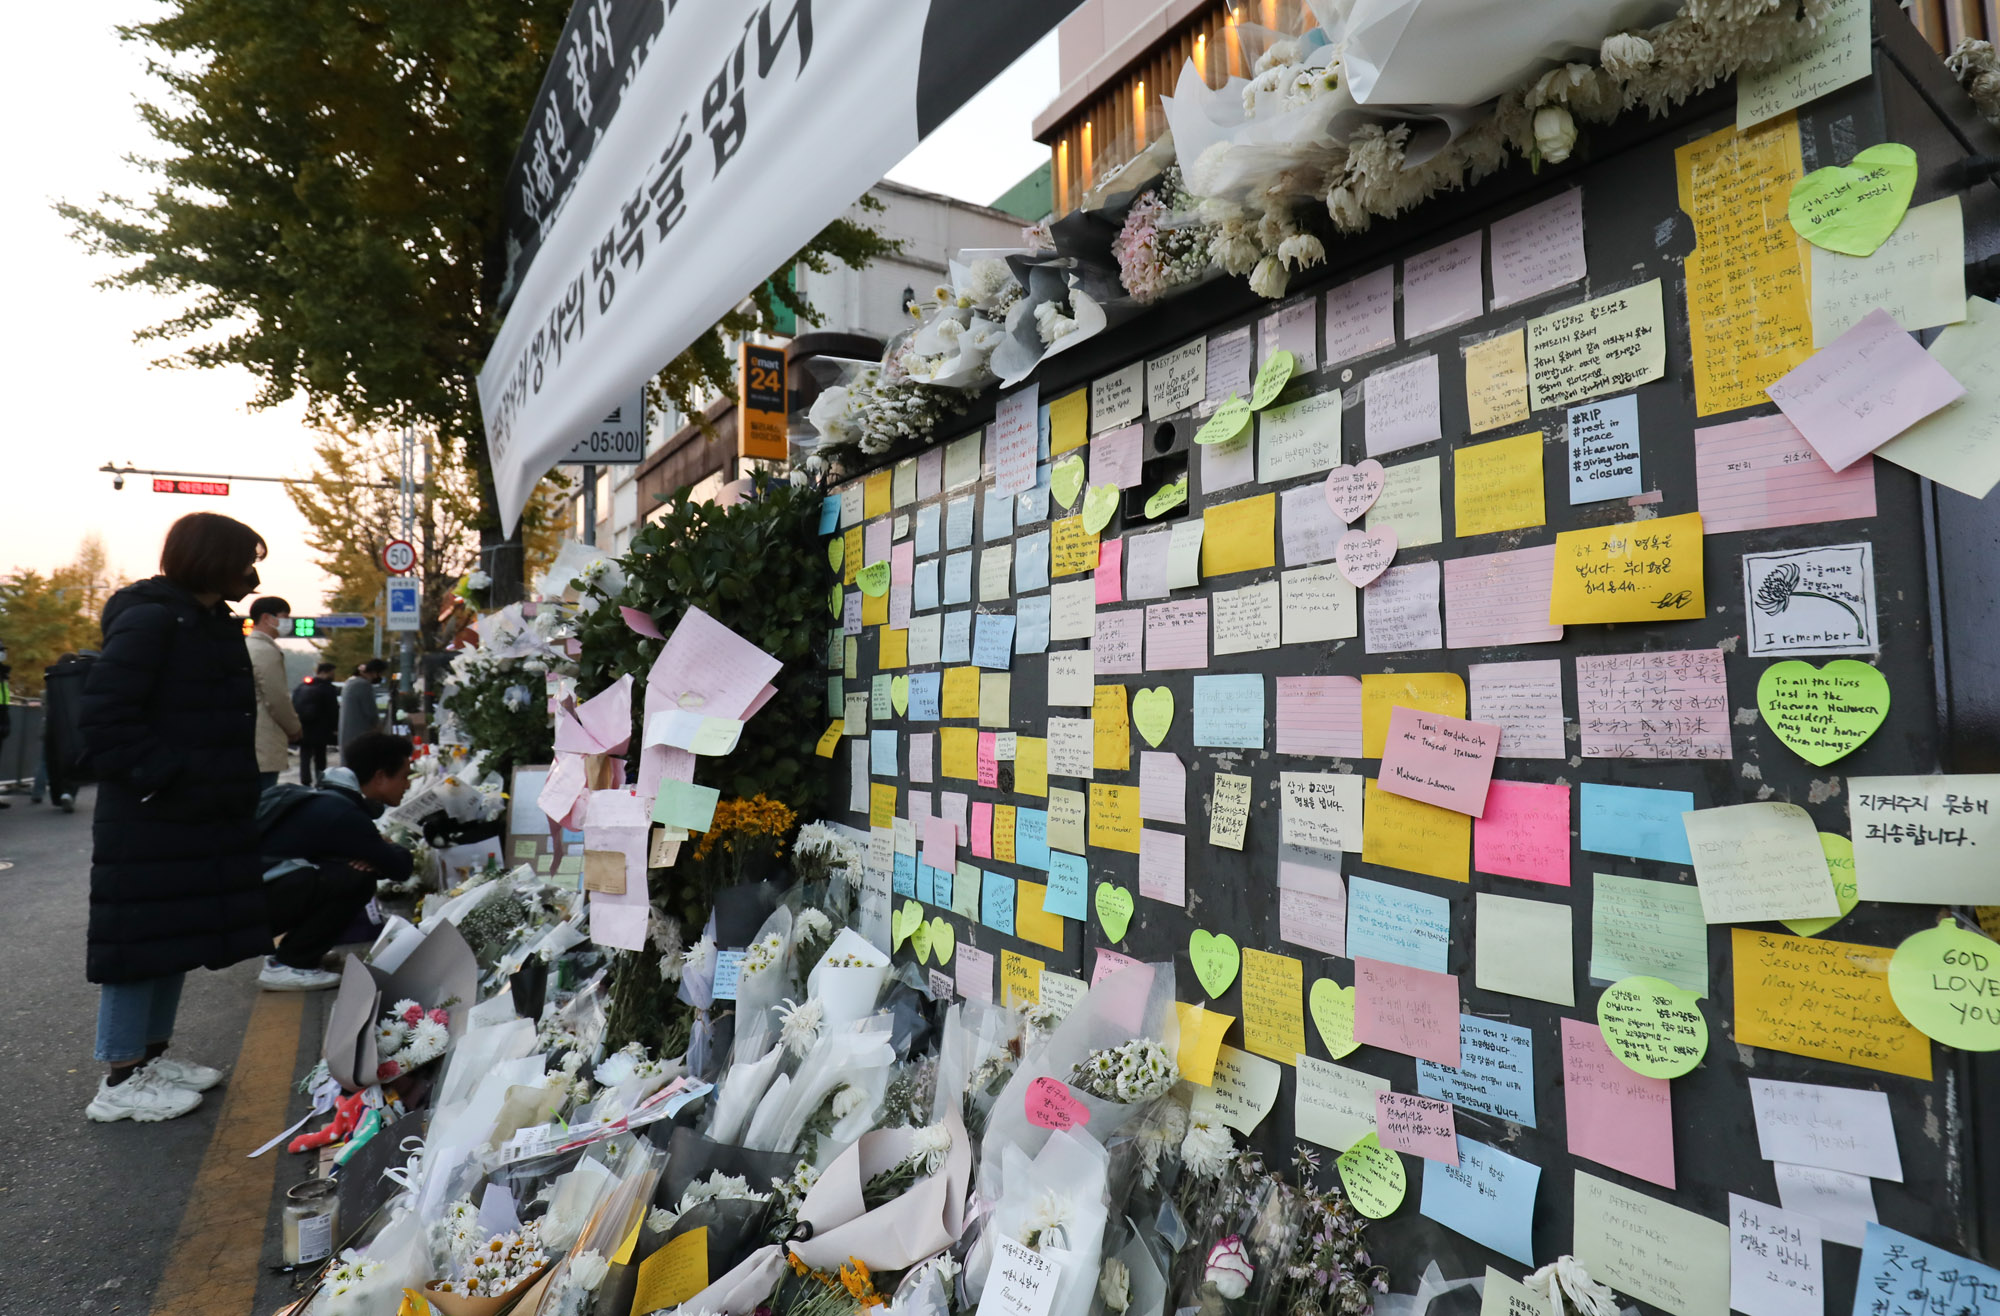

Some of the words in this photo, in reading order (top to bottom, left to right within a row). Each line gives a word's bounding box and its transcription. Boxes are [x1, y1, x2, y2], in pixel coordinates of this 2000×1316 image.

[591, 111, 693, 316] 명복을
[751, 356, 780, 371] emart
[751, 367, 781, 393] 24
[1152, 382, 1167, 394] MAY
[1166, 377, 1180, 391] GOD
[1180, 365, 1197, 384] BLESS
[1153, 391, 1166, 403] THE
[1182, 381, 1191, 391] OF
[1190, 373, 1201, 385] THE
[1572, 408, 1602, 425] #RIP
[1609, 419, 1620, 427] in
[1582, 431, 1615, 447] peace
[1573, 457, 1613, 472] #giving
[1613, 452, 1640, 462] them
[1575, 475, 1584, 483] a
[1589, 466, 1634, 481] closure
[390, 547, 410, 566] 50
[1805, 560, 1853, 579] 하늘에서는
[1305, 591, 1321, 600] you
[1764, 632, 1776, 646] I
[1781, 630, 1852, 645] remember
[1775, 676, 1788, 686] To
[1792, 677, 1808, 686] all
[1811, 677, 1831, 688] the
[1834, 677, 1860, 688] lives
[1775, 689, 1799, 699] lost
[1807, 689, 1819, 699] in
[1822, 690, 1844, 702] the
[1768, 700, 1820, 711] Itaewon
[1780, 713, 1837, 726] accident.
[1810, 726, 1828, 735] we
[1833, 725, 1868, 737] honor
[1785, 734, 1811, 746] them
[1287, 780, 1306, 795] 삼가
[1294, 796, 1316, 810] 명복을
[1318, 796, 1345, 813] 빕니다.
[1859, 793, 1930, 813] 지켜주지
[1942, 793, 1990, 816] 못해
[1864, 822, 1977, 848] 죄송합니다.
[1758, 935, 1776, 949] Be
[1759, 951, 1812, 973] Jesus
[1942, 948, 1990, 973] GOD
[1761, 973, 1796, 998] May
[1799, 977, 1826, 995] the
[1932, 973, 2000, 998] LOVE
[1949, 1001, 2000, 1026] YOU
[1809, 1019, 1830, 1035] the
[1738, 1208, 1761, 1231] 삼가
[1768, 1224, 1802, 1247] 고인의
[1739, 1233, 1769, 1258] 명복을
[1776, 1244, 1813, 1272] 빕니다.
